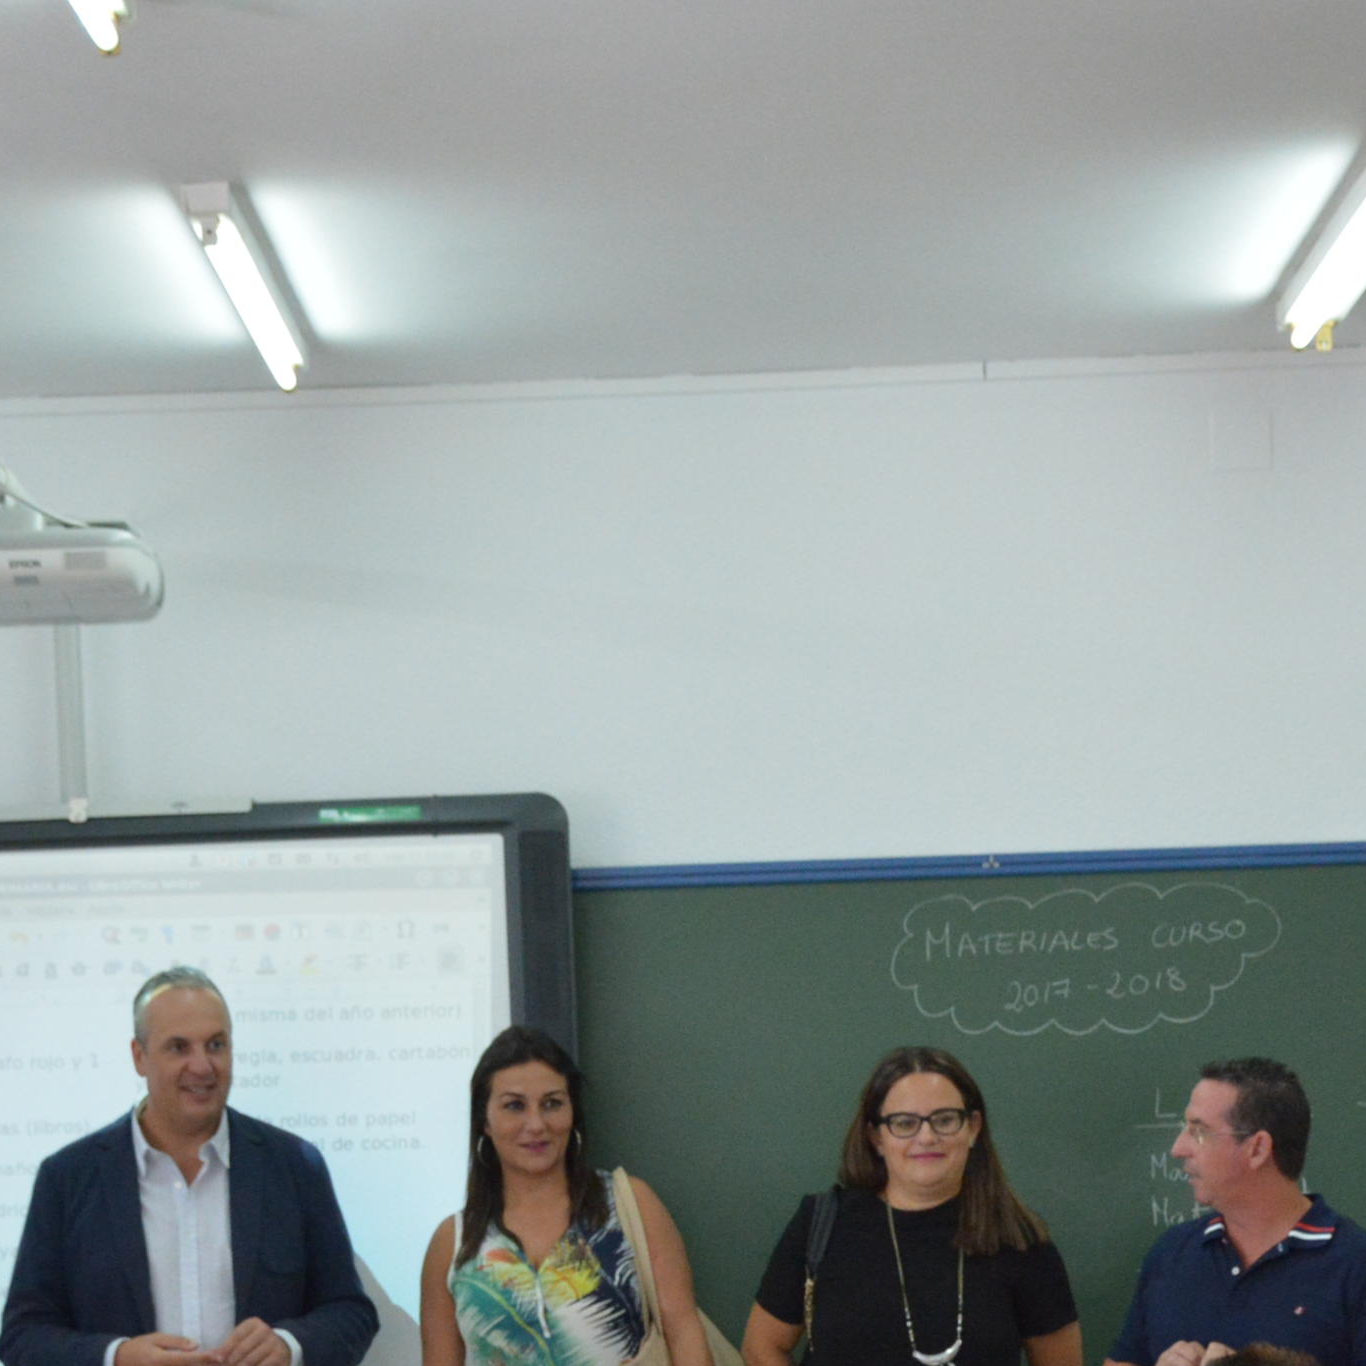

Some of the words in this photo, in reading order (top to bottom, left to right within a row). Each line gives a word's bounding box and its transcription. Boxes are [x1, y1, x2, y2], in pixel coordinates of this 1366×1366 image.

[925, 921, 1119, 962] MATERIALES
[1151, 919, 1246, 948] CURSO
[304, 1006, 333, 1022] del
[339, 1005, 374, 1021] año
[381, 1002, 462, 1021] anterior)
[29, 1054, 66, 1074] rojo
[334, 1111, 359, 1128] de
[365, 1110, 417, 1131] papel
[330, 1136, 355, 1153] de
